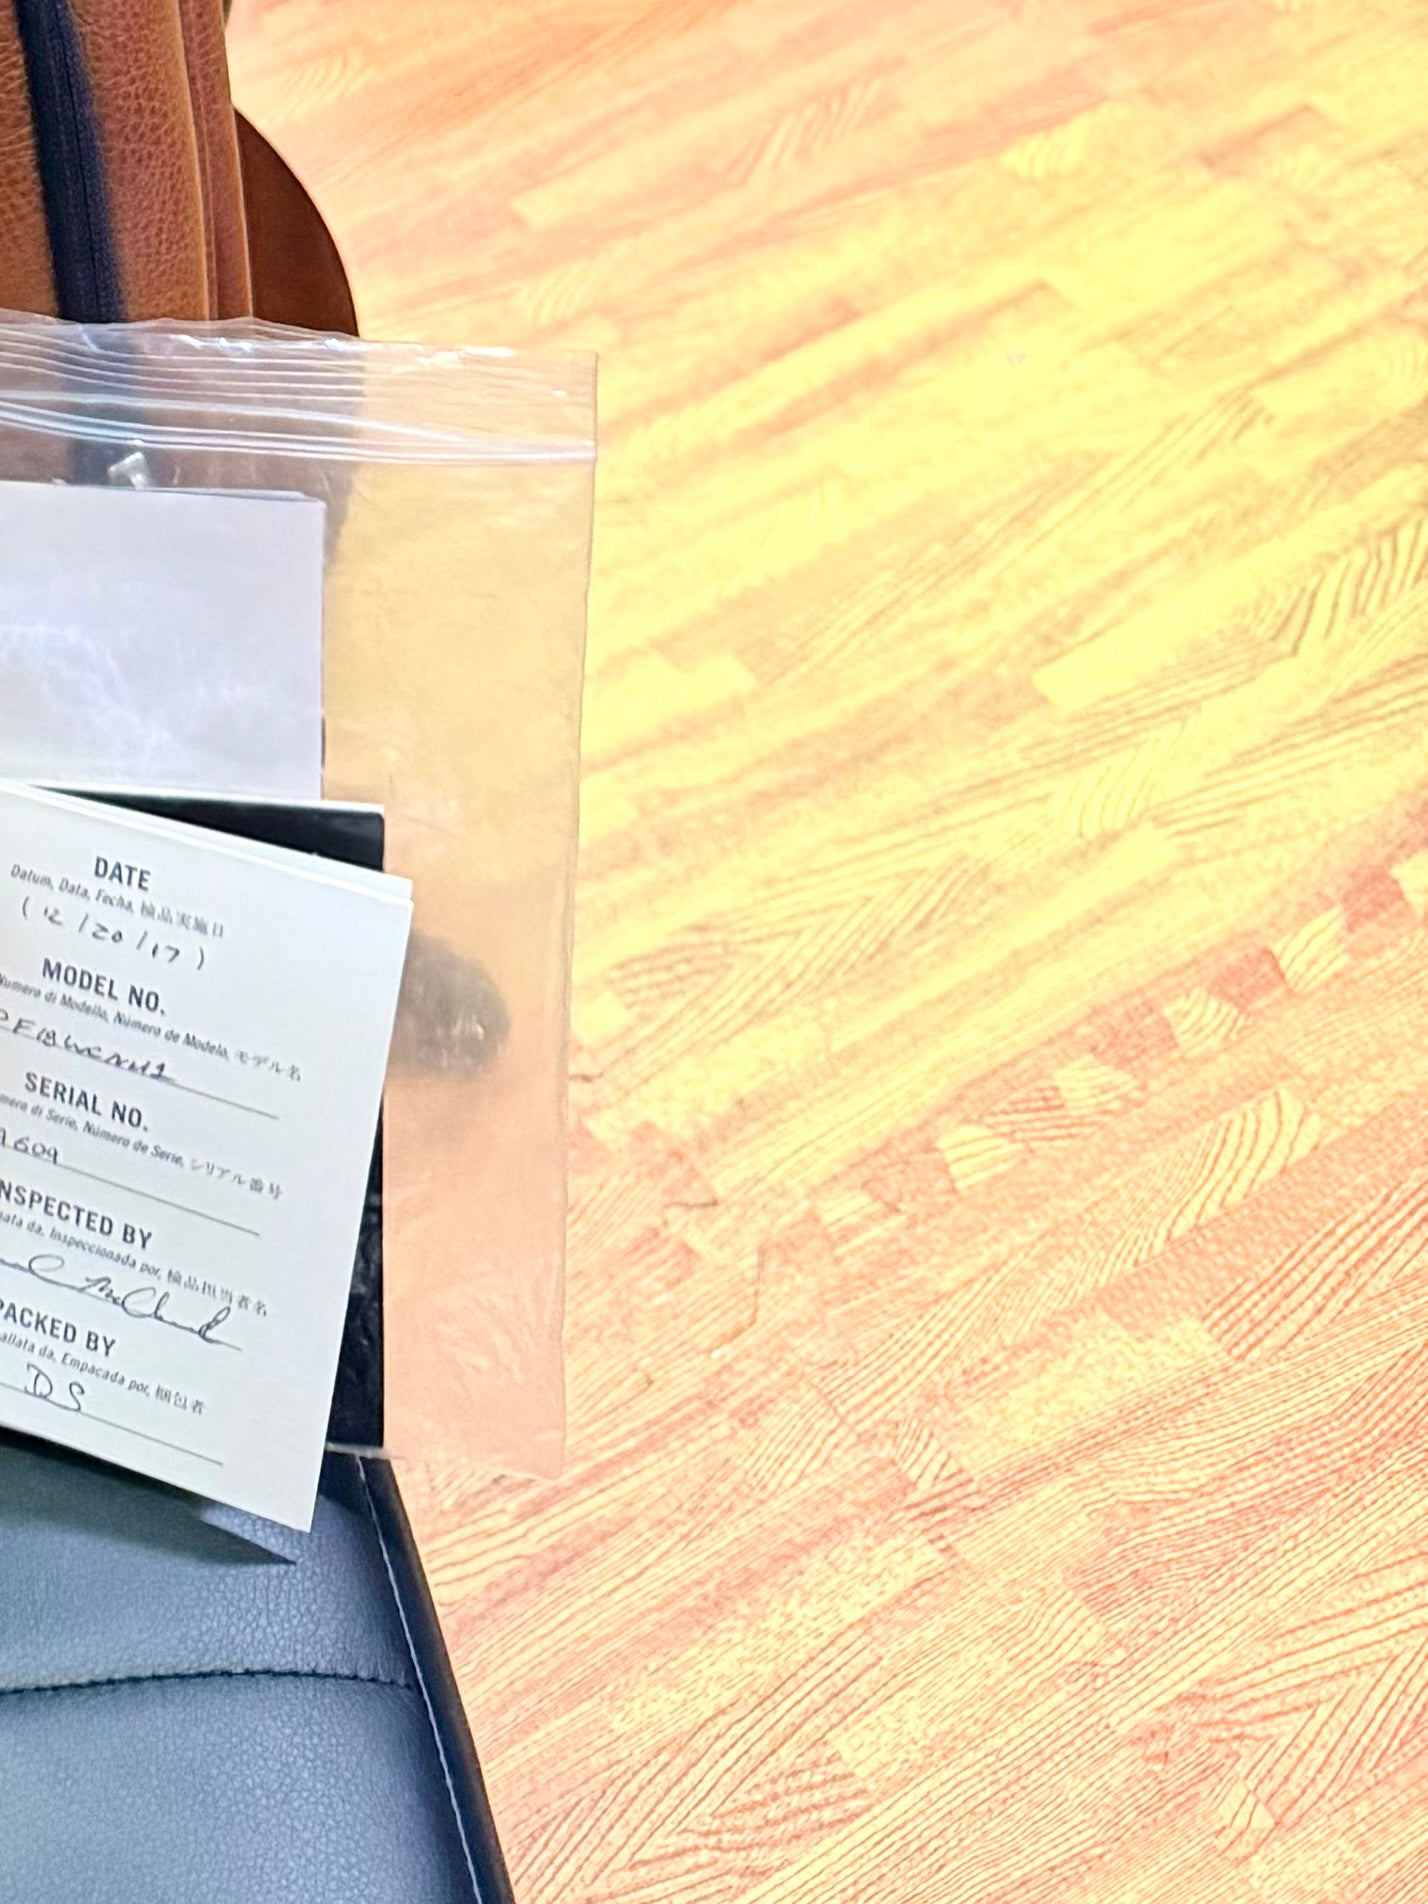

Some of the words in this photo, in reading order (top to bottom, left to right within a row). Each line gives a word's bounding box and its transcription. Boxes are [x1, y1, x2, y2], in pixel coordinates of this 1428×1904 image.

[11, 864, 54, 890] Datum,
[94, 856, 151, 891] DATE
[43, 958, 119, 1001] MODEL
[128, 984, 166, 1016] NO.
[165, 1029, 181, 1043] de
[24, 1071, 102, 1116] SERIAL
[111, 1101, 148, 1133] NO.
[133, 1139, 149, 1155] de
[122, 1222, 153, 1250] BY
[85, 1330, 117, 1358] BY
[61, 1352, 125, 1386] Empacada
[128, 1378, 151, 1398] por,
